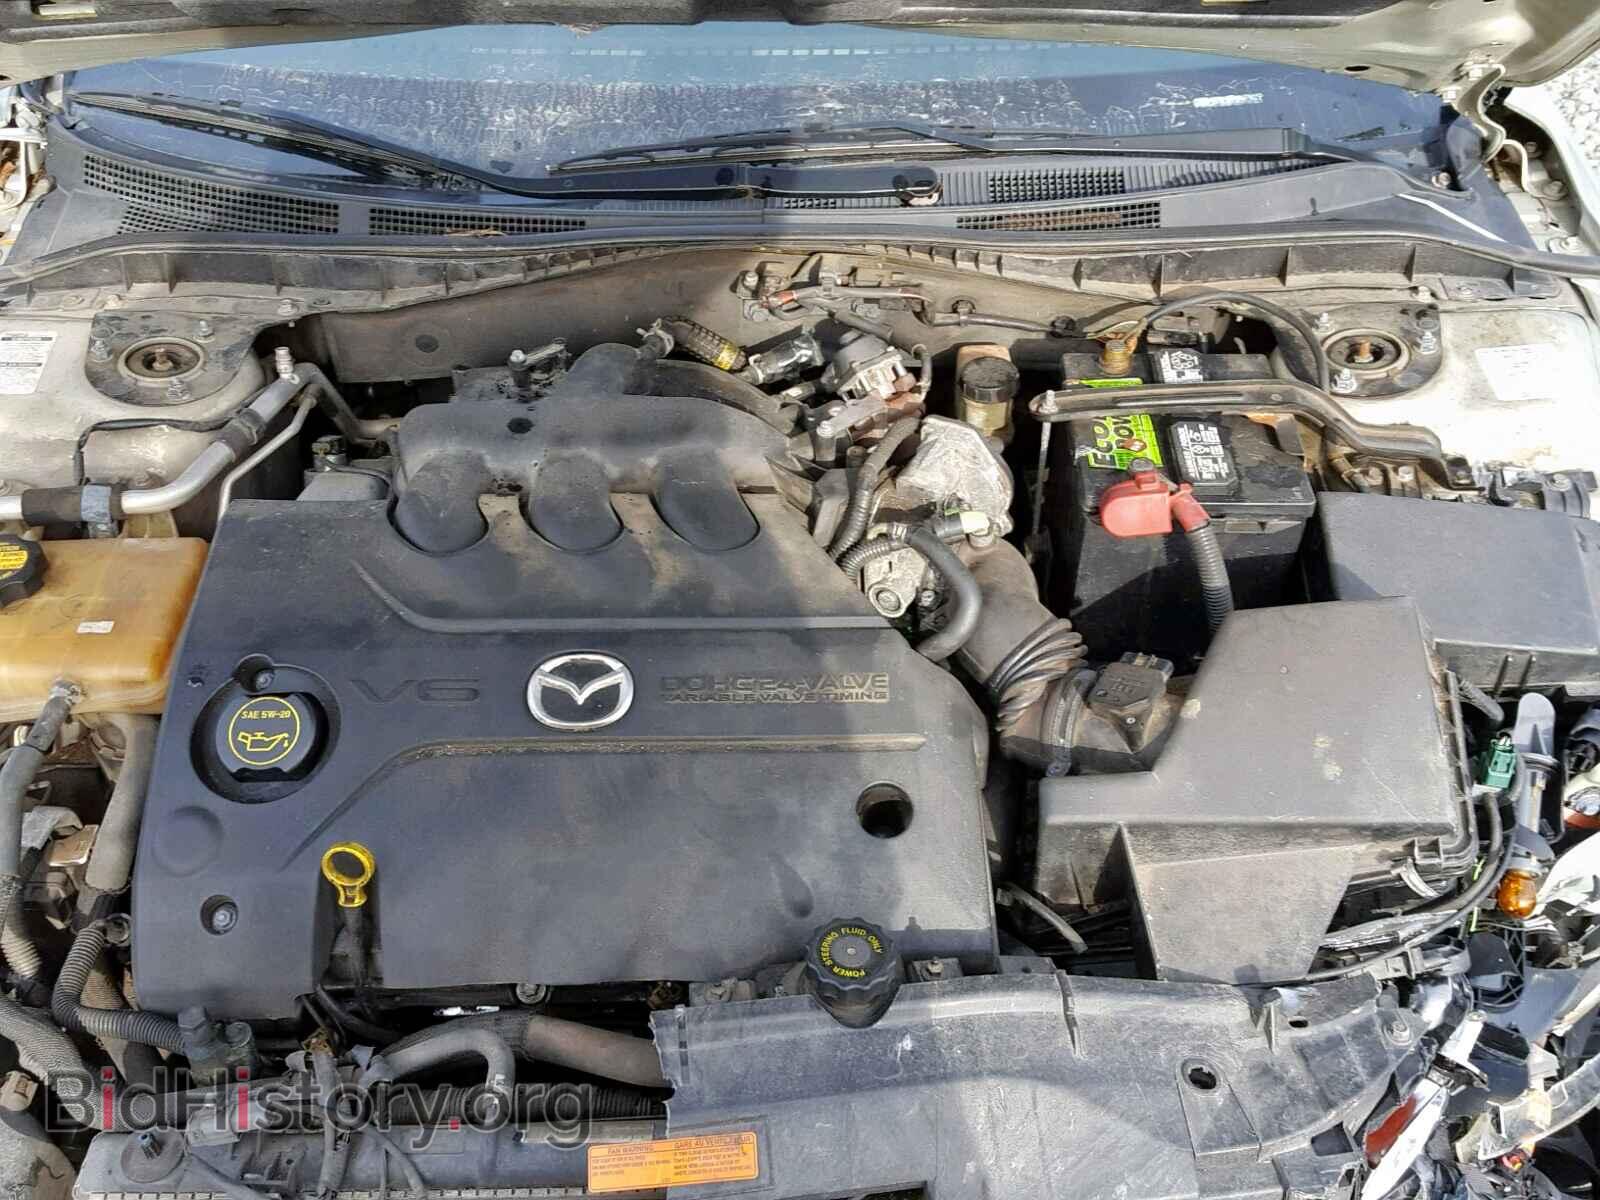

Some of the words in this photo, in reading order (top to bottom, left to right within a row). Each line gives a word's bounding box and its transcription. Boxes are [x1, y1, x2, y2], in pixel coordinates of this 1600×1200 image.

[241, 710, 259, 719] SAE
[841, 927, 867, 936] FLUID
[820, 931, 839, 966] STEERING
[867, 935, 884, 953] ONLY
[832, 965, 866, 978] POWER
